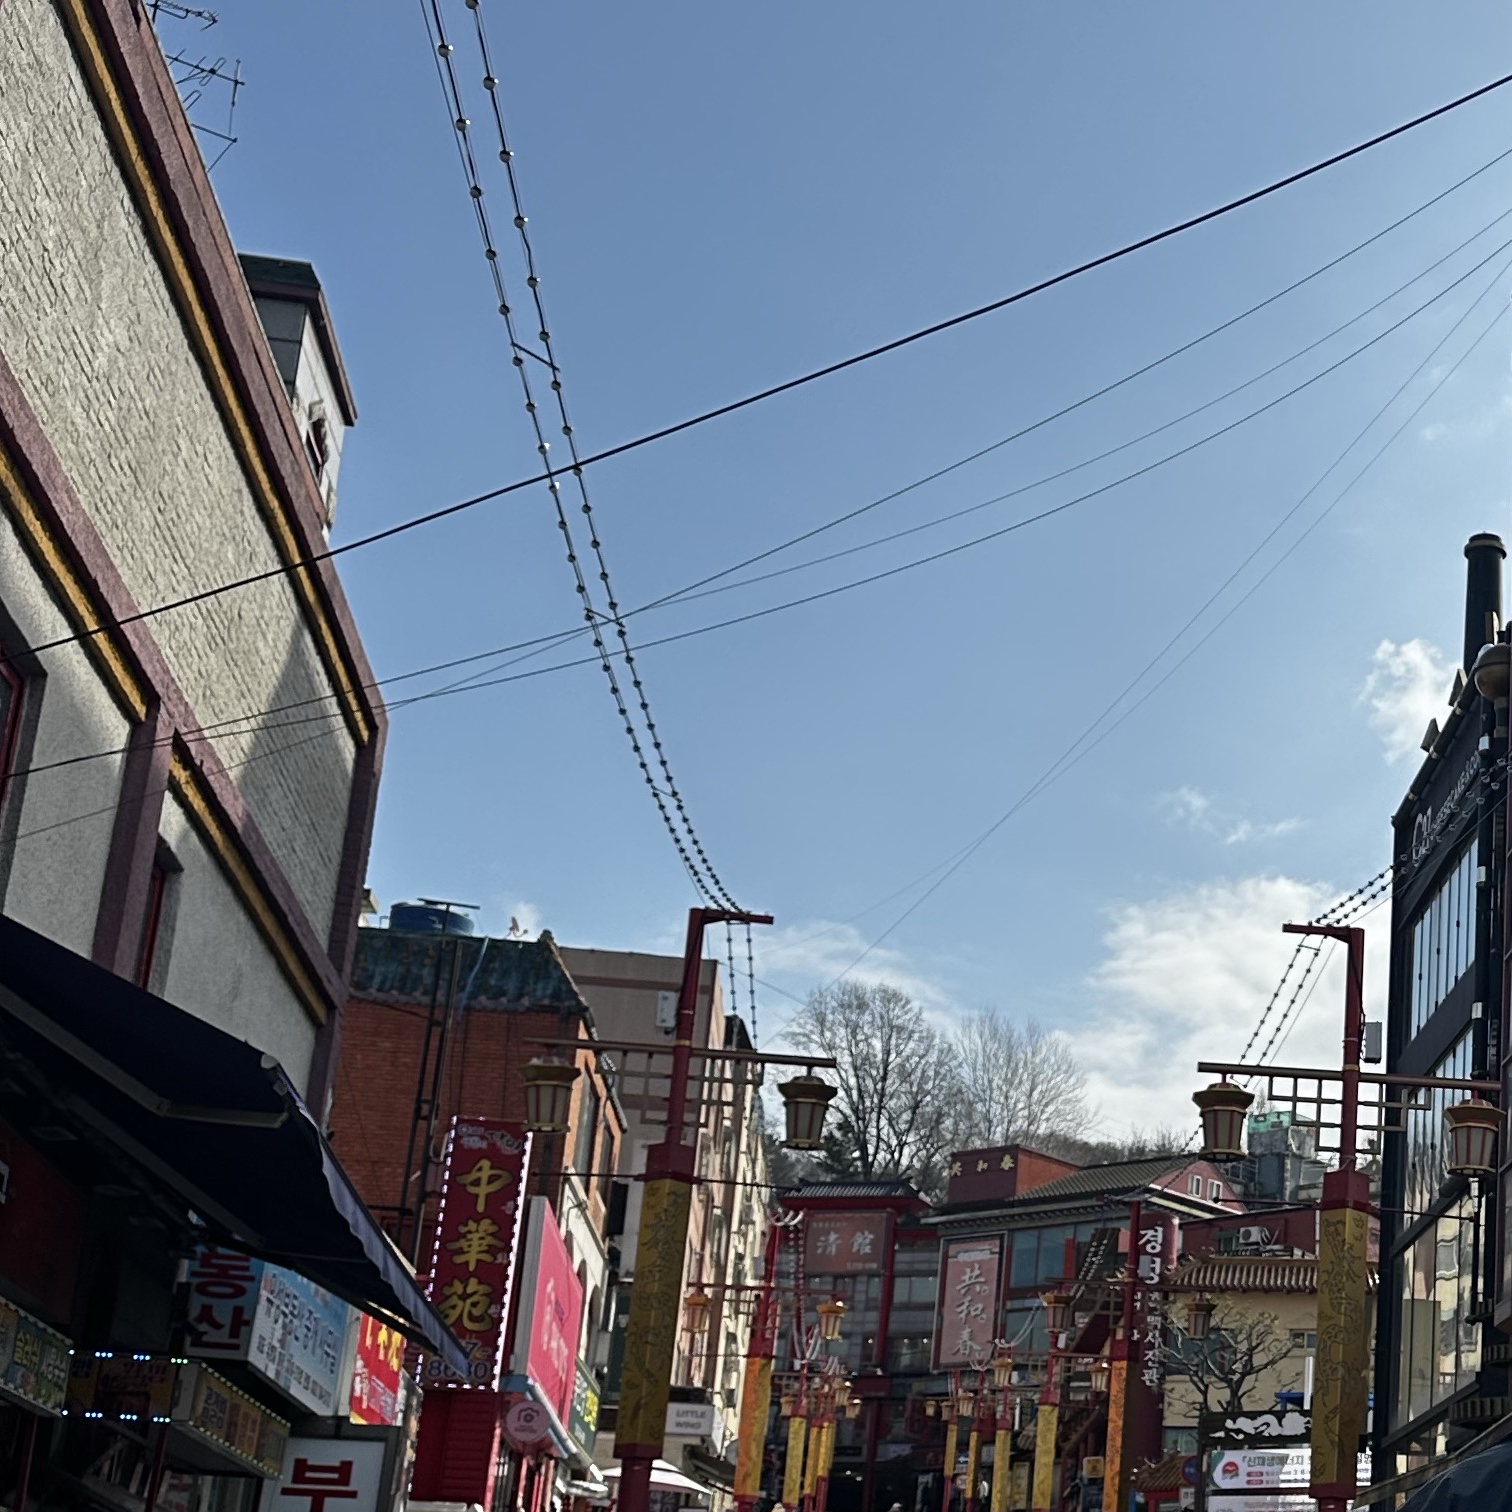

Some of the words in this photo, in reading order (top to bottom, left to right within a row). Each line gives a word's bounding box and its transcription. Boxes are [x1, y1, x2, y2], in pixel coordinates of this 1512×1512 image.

[439, 1158, 513, 1332] 中華苑
[676, 1409, 706, 1419] LITTLE
[675, 1420, 701, 1430] WING
